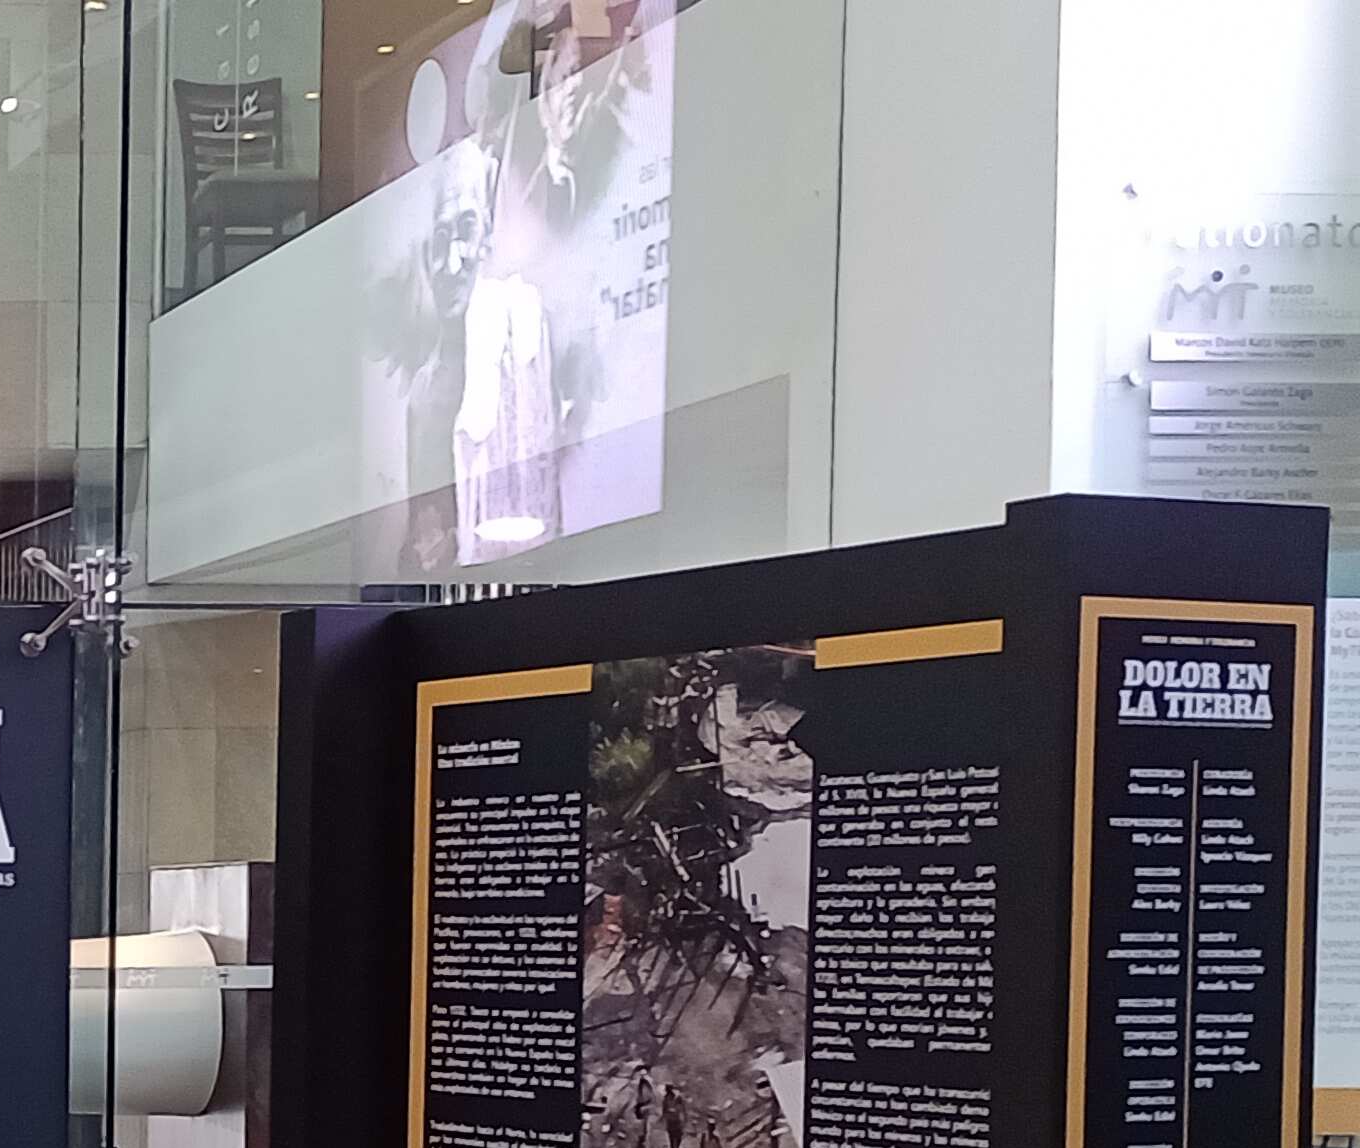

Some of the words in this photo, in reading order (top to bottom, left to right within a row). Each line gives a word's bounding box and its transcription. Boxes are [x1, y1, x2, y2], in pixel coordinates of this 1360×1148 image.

[1123, 659, 1222, 690] DOLOR
[1227, 663, 1272, 691] EN
[1118, 689, 1158, 718] LA
[1163, 691, 1274, 721] TIERRA
